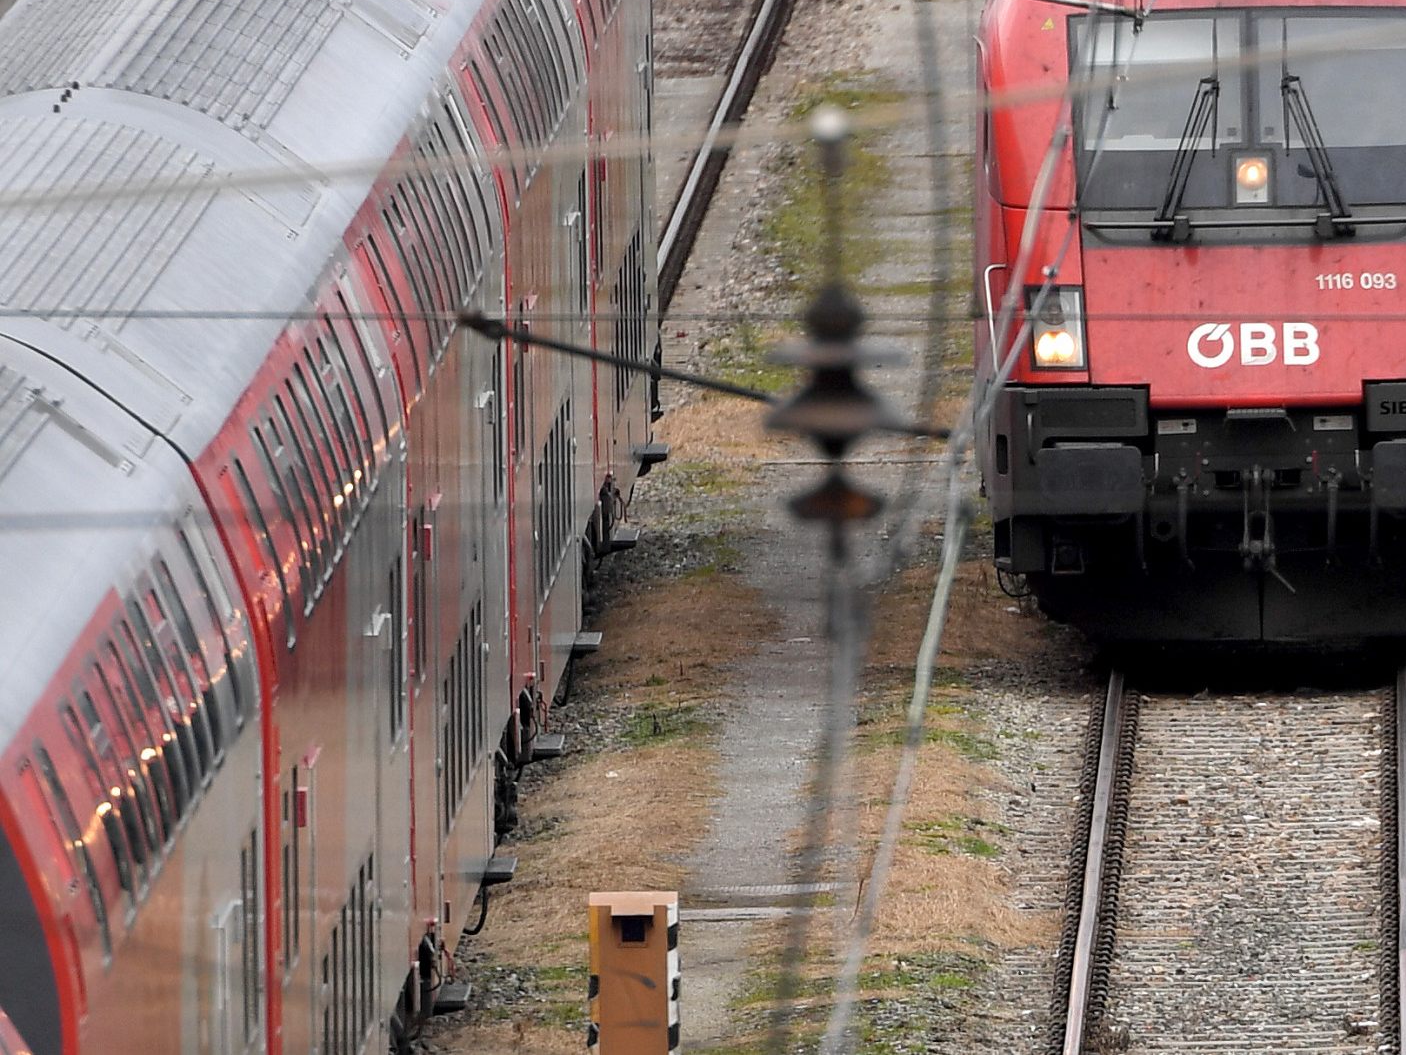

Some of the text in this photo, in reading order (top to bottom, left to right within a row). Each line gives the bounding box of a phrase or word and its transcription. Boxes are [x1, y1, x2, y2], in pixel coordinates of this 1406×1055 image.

[1315, 272, 1397, 290] 1116 093
[1187, 322, 1320, 368] ÖBB
